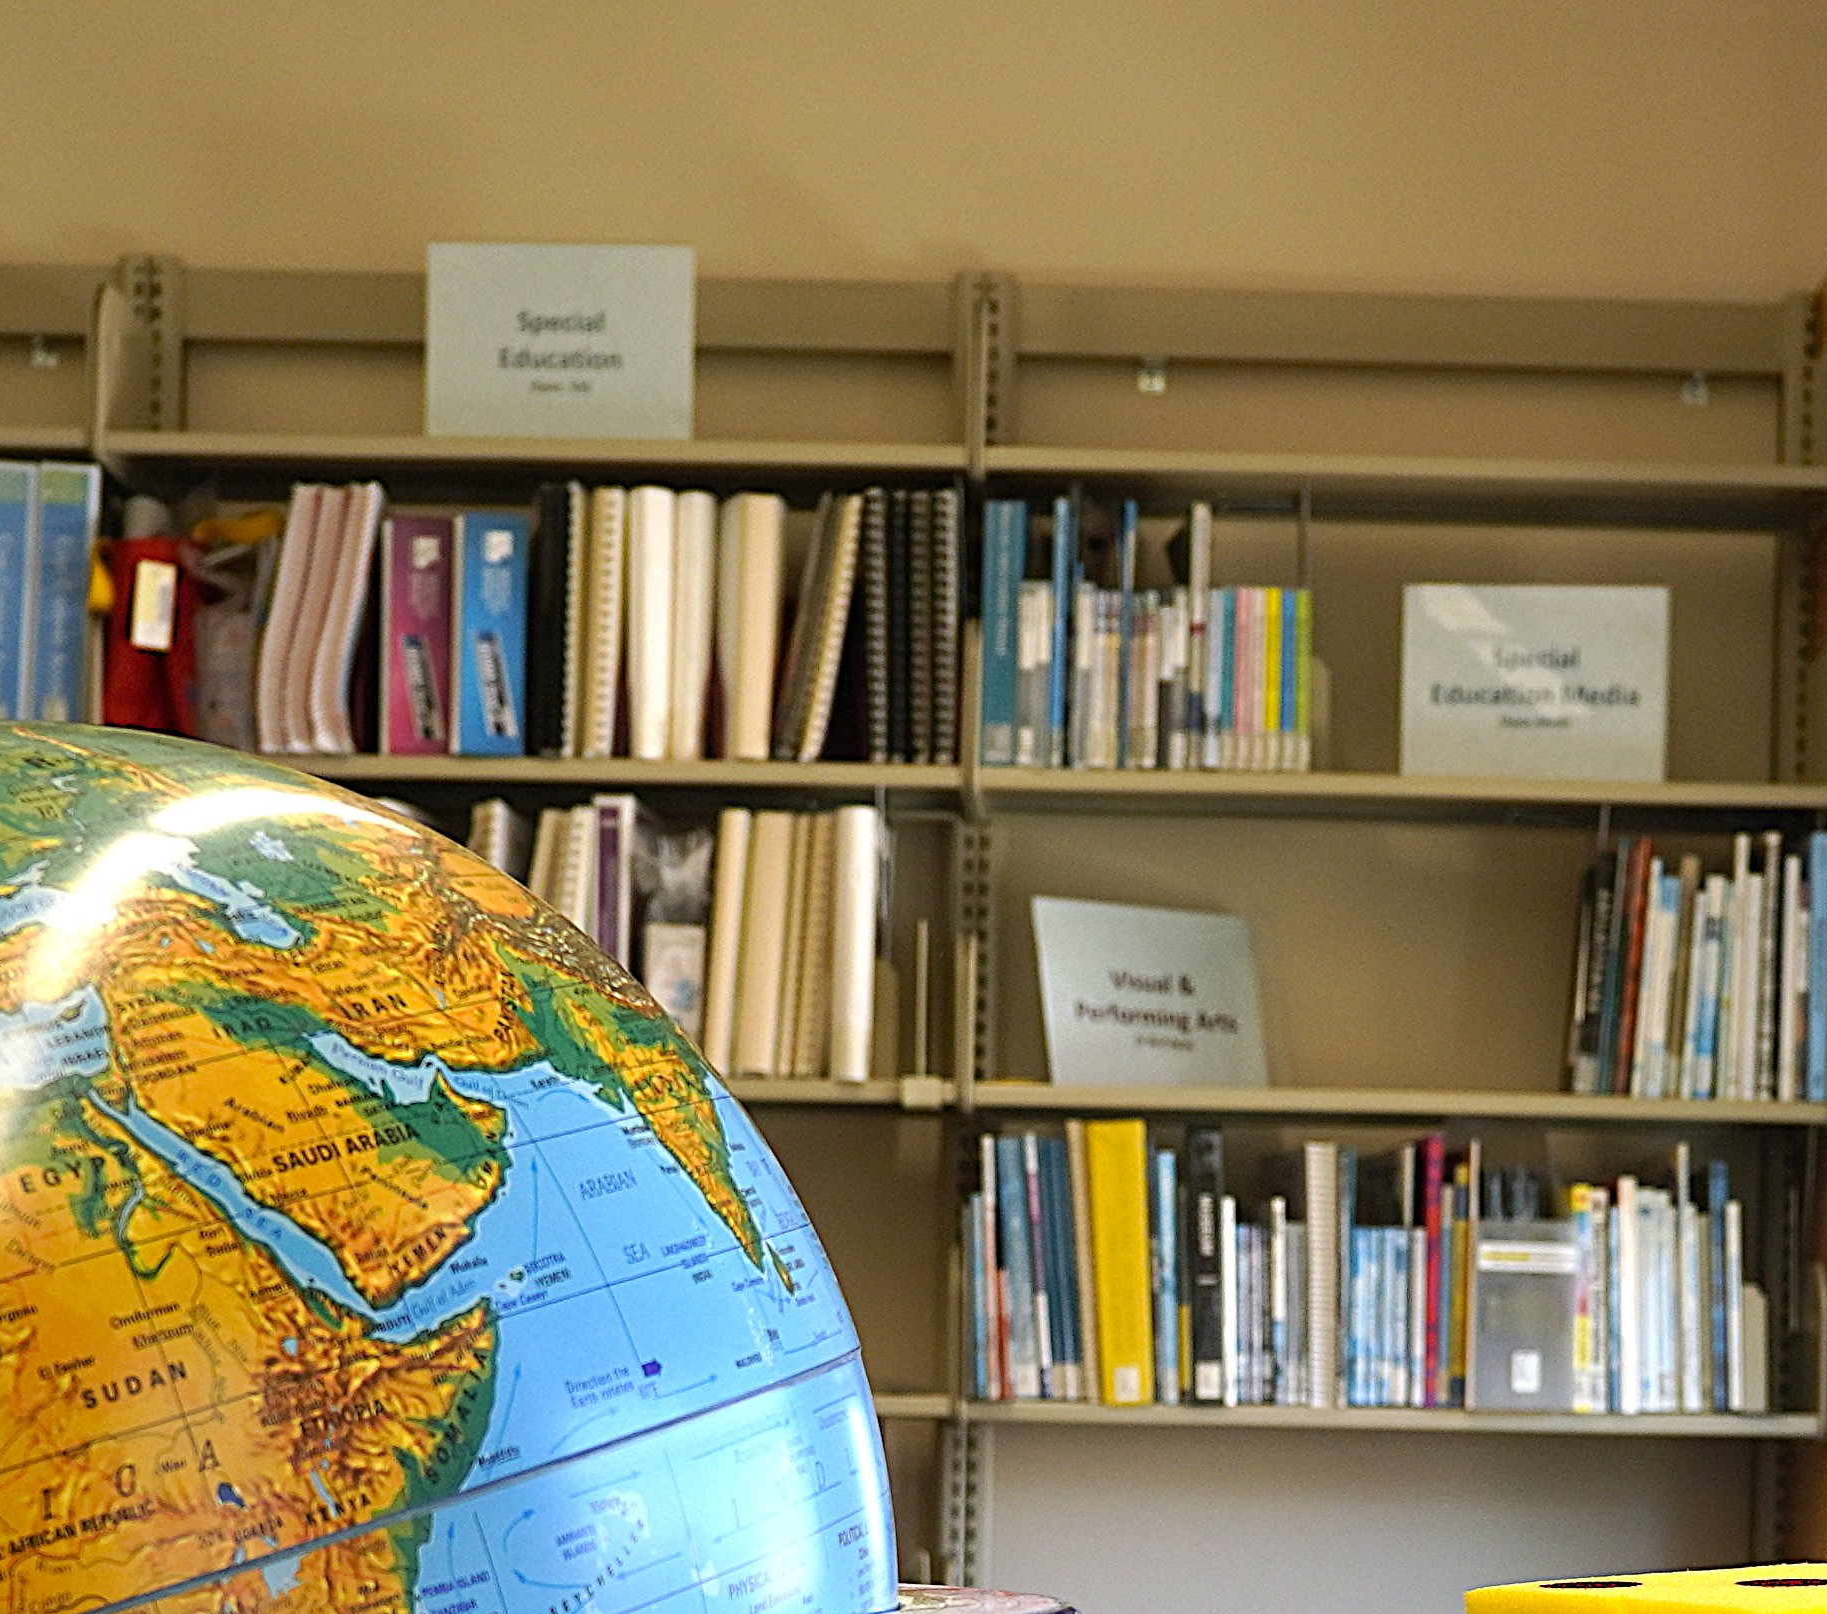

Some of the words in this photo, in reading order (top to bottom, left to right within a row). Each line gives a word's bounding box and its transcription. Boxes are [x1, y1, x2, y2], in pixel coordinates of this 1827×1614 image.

[517, 310, 605, 339] Special
[498, 346, 622, 372] Education
[1109, 970, 1172, 995] Visual
[340, 993, 408, 1020] IRAN
[1075, 999, 1190, 1034] Performing
[1197, 1009, 1238, 1034] Arts
[391, 1067, 424, 1091] Gulf
[273, 1141, 341, 1174] SAUDI
[345, 1125, 421, 1159] ARABIA
[578, 1169, 637, 1200] ARABIAN
[624, 1241, 652, 1264] SEA
[81, 1361, 189, 1410] SUDAN
